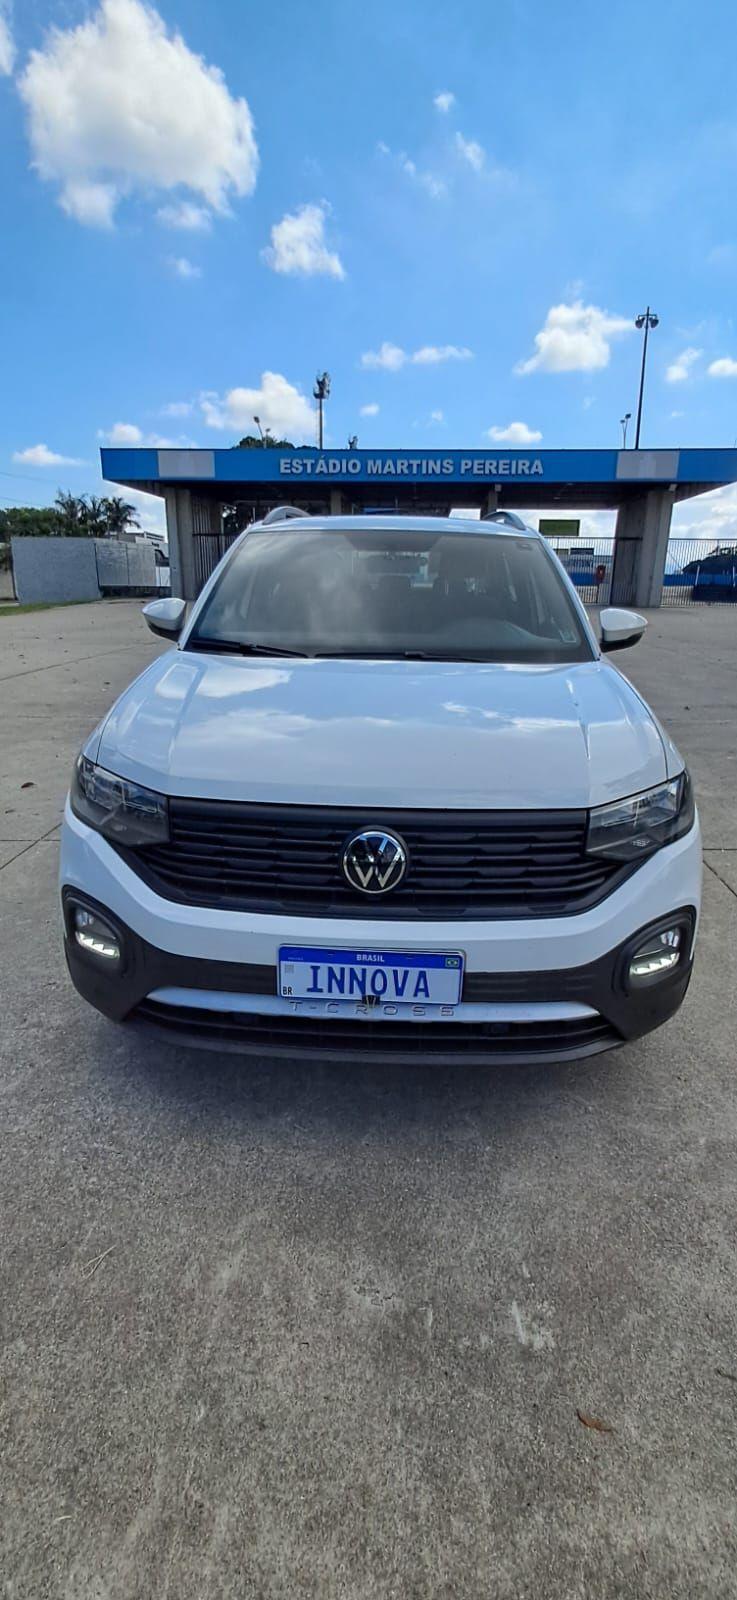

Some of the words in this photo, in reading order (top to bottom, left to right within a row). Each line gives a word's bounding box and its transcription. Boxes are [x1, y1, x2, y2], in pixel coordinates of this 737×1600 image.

[280, 455, 361, 474] ESTÁDIO
[367, 459, 454, 474] MARTINS
[461, 459, 544, 474] PEREIRA
[345, 833, 403, 889] VW
[356, 953, 385, 963] BRASIL
[306, 965, 431, 998] INNOVA
[282, 986, 293, 996] BR
[289, 1001, 455, 1017] T-CROSS
